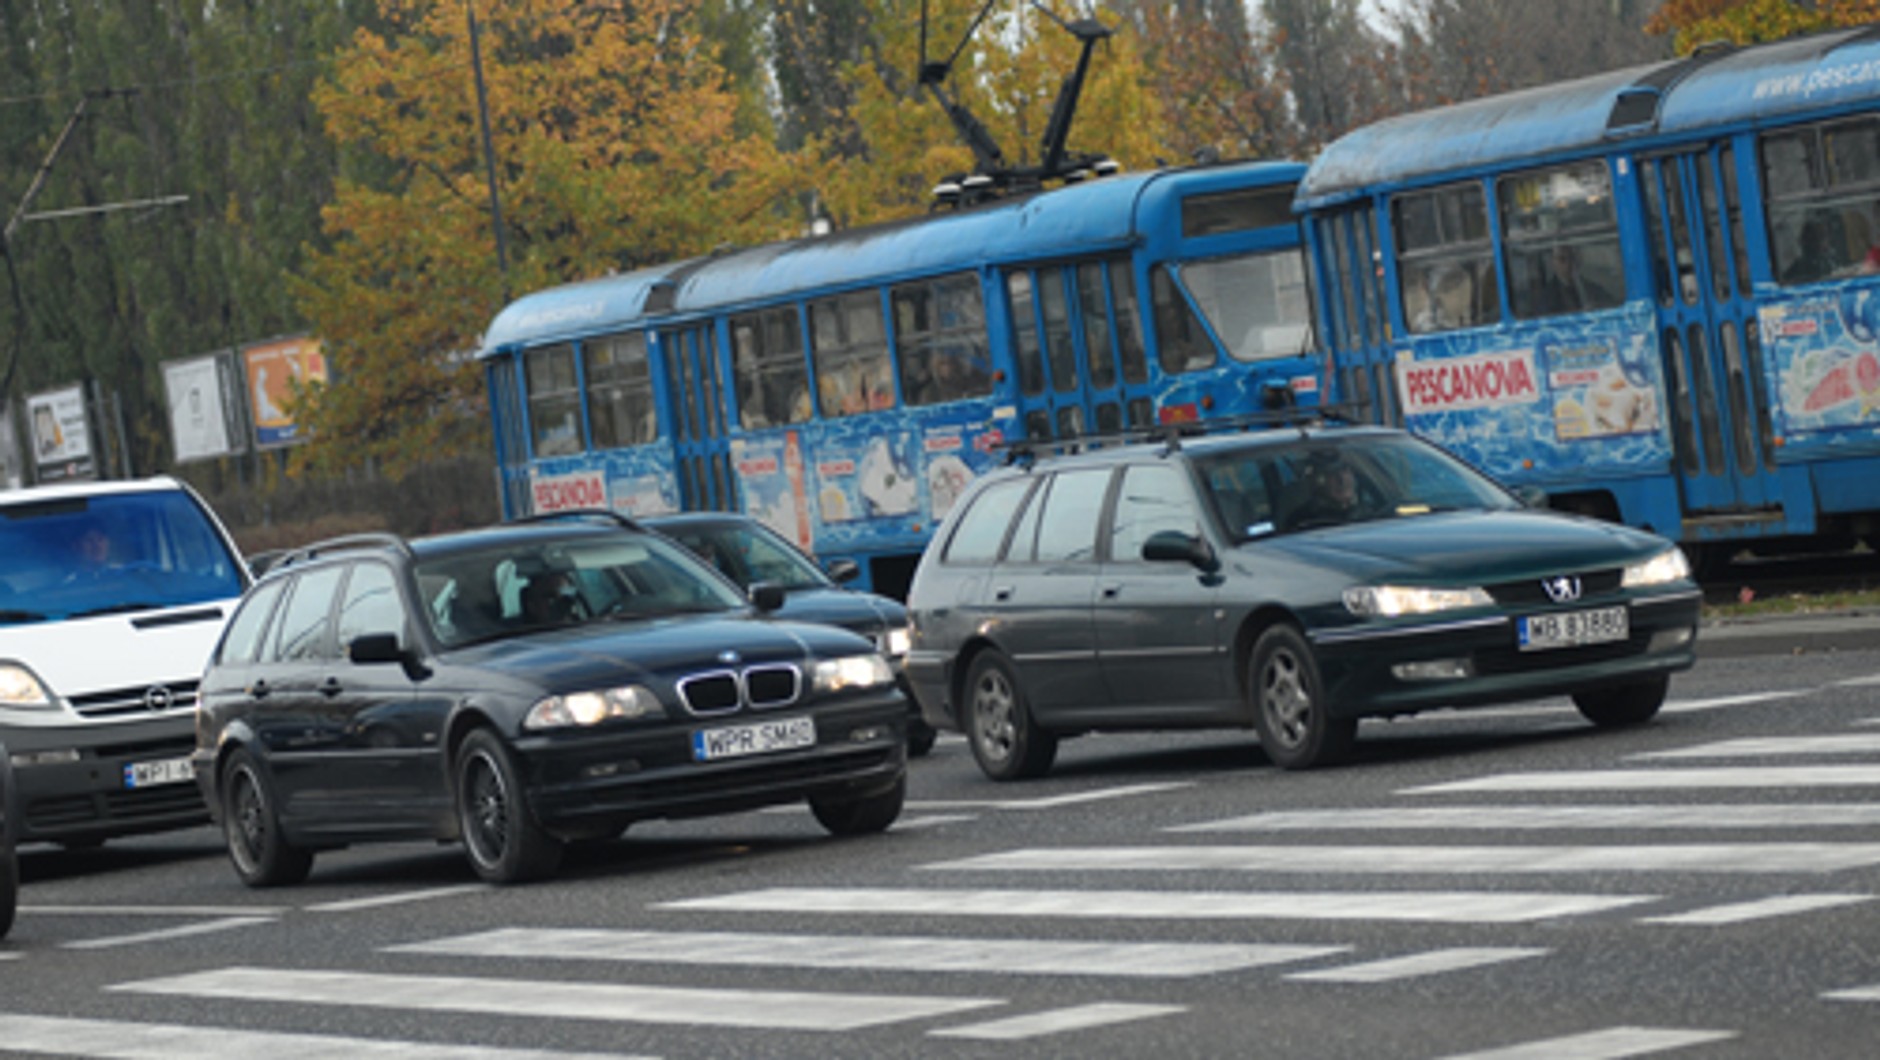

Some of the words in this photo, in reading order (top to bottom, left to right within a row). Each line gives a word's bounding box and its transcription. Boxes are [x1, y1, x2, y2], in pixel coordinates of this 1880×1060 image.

[1406, 357, 1535, 405] PESCANOVA
[1530, 616, 1560, 639] WB
[707, 727, 753, 754] WPR
